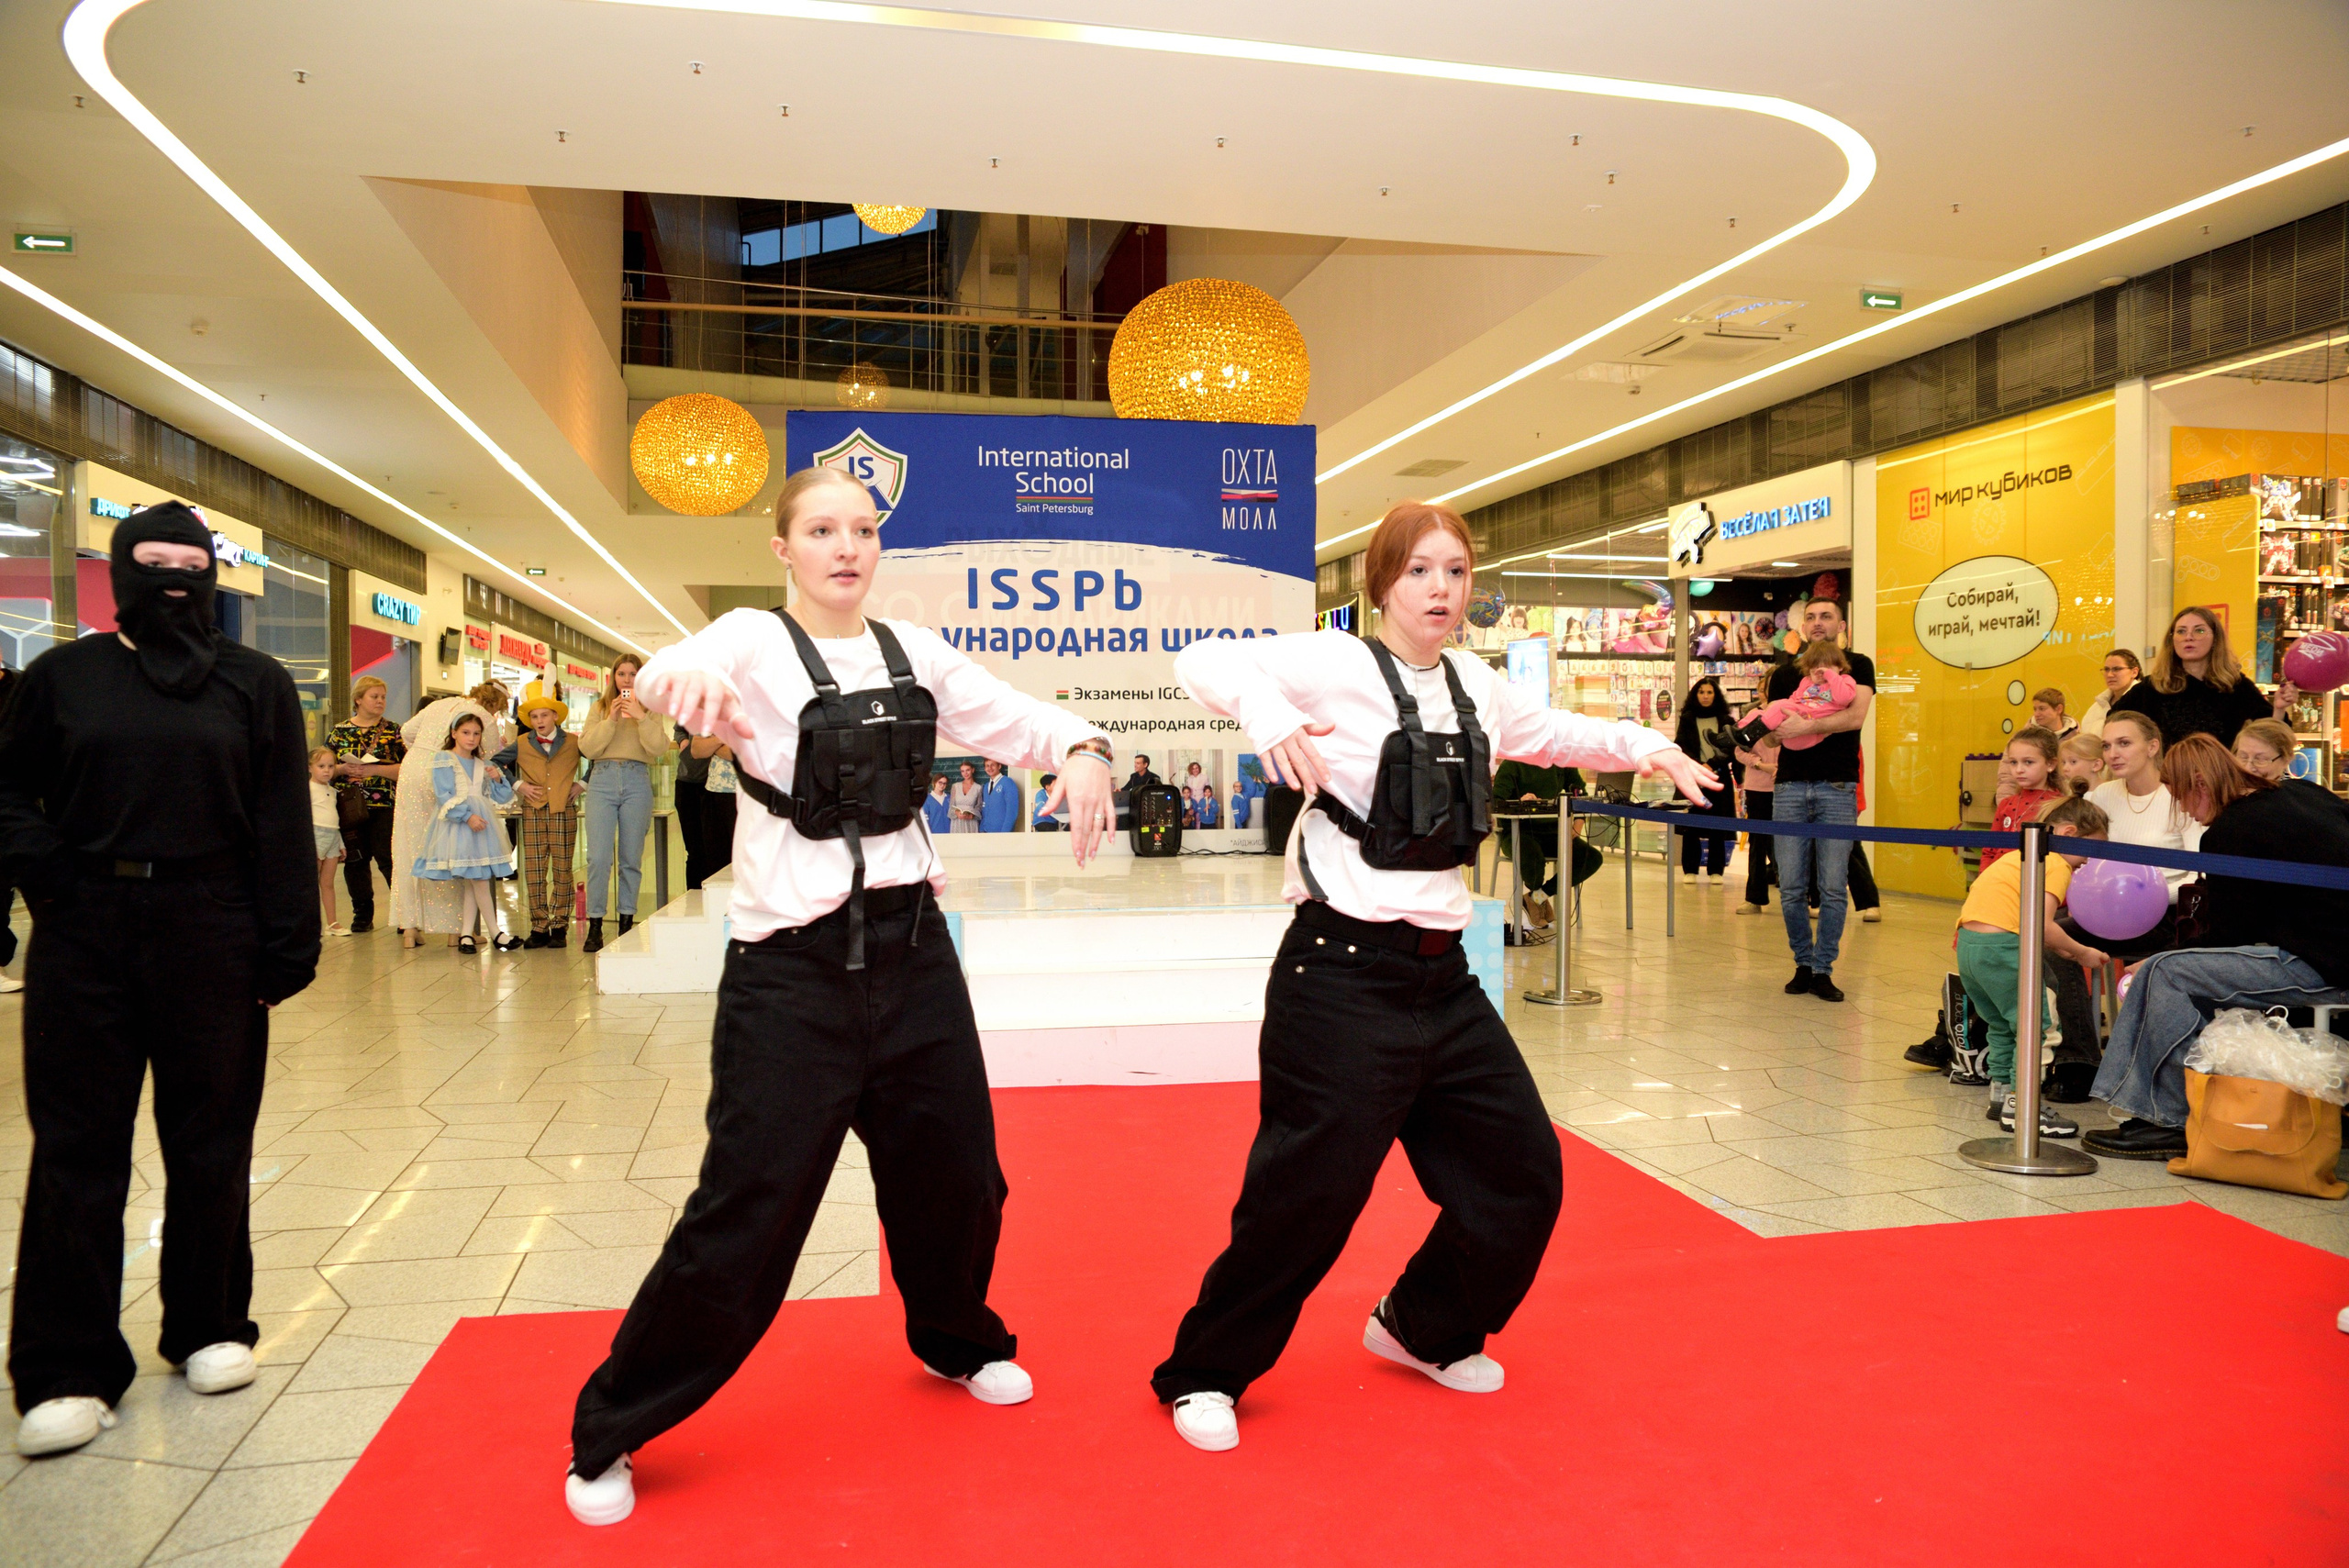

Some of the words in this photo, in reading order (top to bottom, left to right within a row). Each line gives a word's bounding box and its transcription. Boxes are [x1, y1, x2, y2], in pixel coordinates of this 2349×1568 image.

[848, 456, 874, 480] IS
[978, 445, 1130, 469] International
[1222, 448, 1278, 484] ОХТА
[1015, 472, 1094, 494] School
[1935, 486, 1974, 507] мир
[1976, 464, 2073, 501] кубиков
[1016, 503, 1040, 513] Saint
[1042, 504, 1094, 516] Petersburg
[1720, 510, 1780, 540] ВЕСЁЛАЯ
[1781, 496, 1831, 526] ЗАТЕЯ
[968, 567, 1142, 612] ISSPb
[1946, 582, 2019, 607] Собирай,
[375, 592, 404, 622] CRAZY
[406, 602, 421, 626] ТИР
[1928, 615, 1974, 639] играй,
[1979, 607, 2040, 632] мечтай!
[928, 627, 1148, 660] ународная
[1074, 687, 1153, 700] Экзамены
[1084, 717, 1205, 733] ждународная
